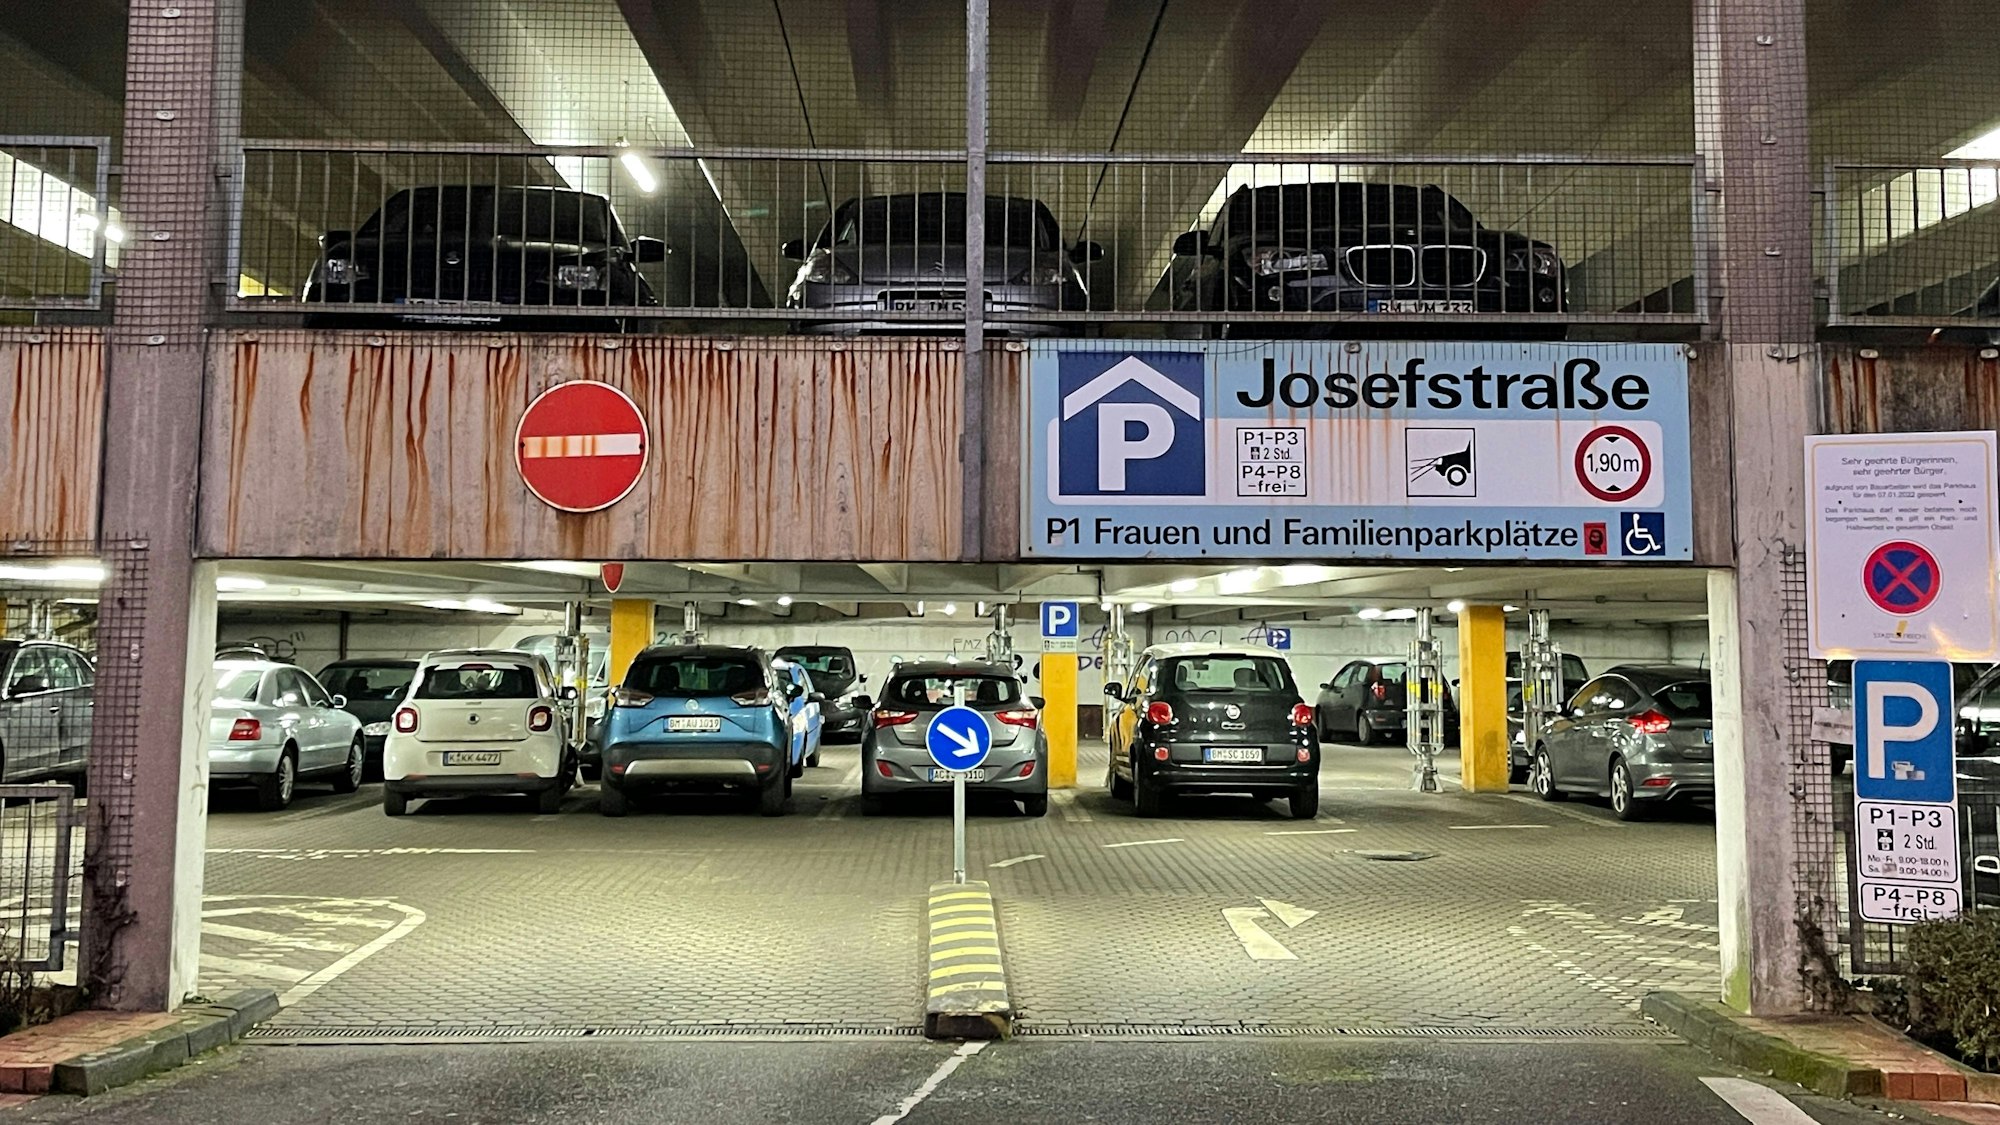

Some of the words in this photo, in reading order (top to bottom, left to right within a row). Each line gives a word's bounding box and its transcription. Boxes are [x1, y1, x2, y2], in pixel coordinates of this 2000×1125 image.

[1236, 357, 1650, 410] Josefstraße
[1098, 402, 1176, 492] P
[1244, 431, 1299, 446] P1-P3
[1263, 447, 1270, 460] 2
[1273, 447, 1292, 460] Std.
[1242, 465, 1301, 479] P4-P8
[1046, 517, 1080, 545] P1
[1095, 517, 1200, 545] Frauen
[1213, 518, 1271, 545] und
[1283, 518, 1579, 553] Familienparkplätze
[1048, 605, 1072, 635] P
[1866, 680, 1940, 779] P
[1870, 807, 1943, 828] P1-P3
[1903, 833, 1911, 849] 2
[1915, 834, 1938, 850] Std.
[1874, 887, 1946, 906] P4-P8
